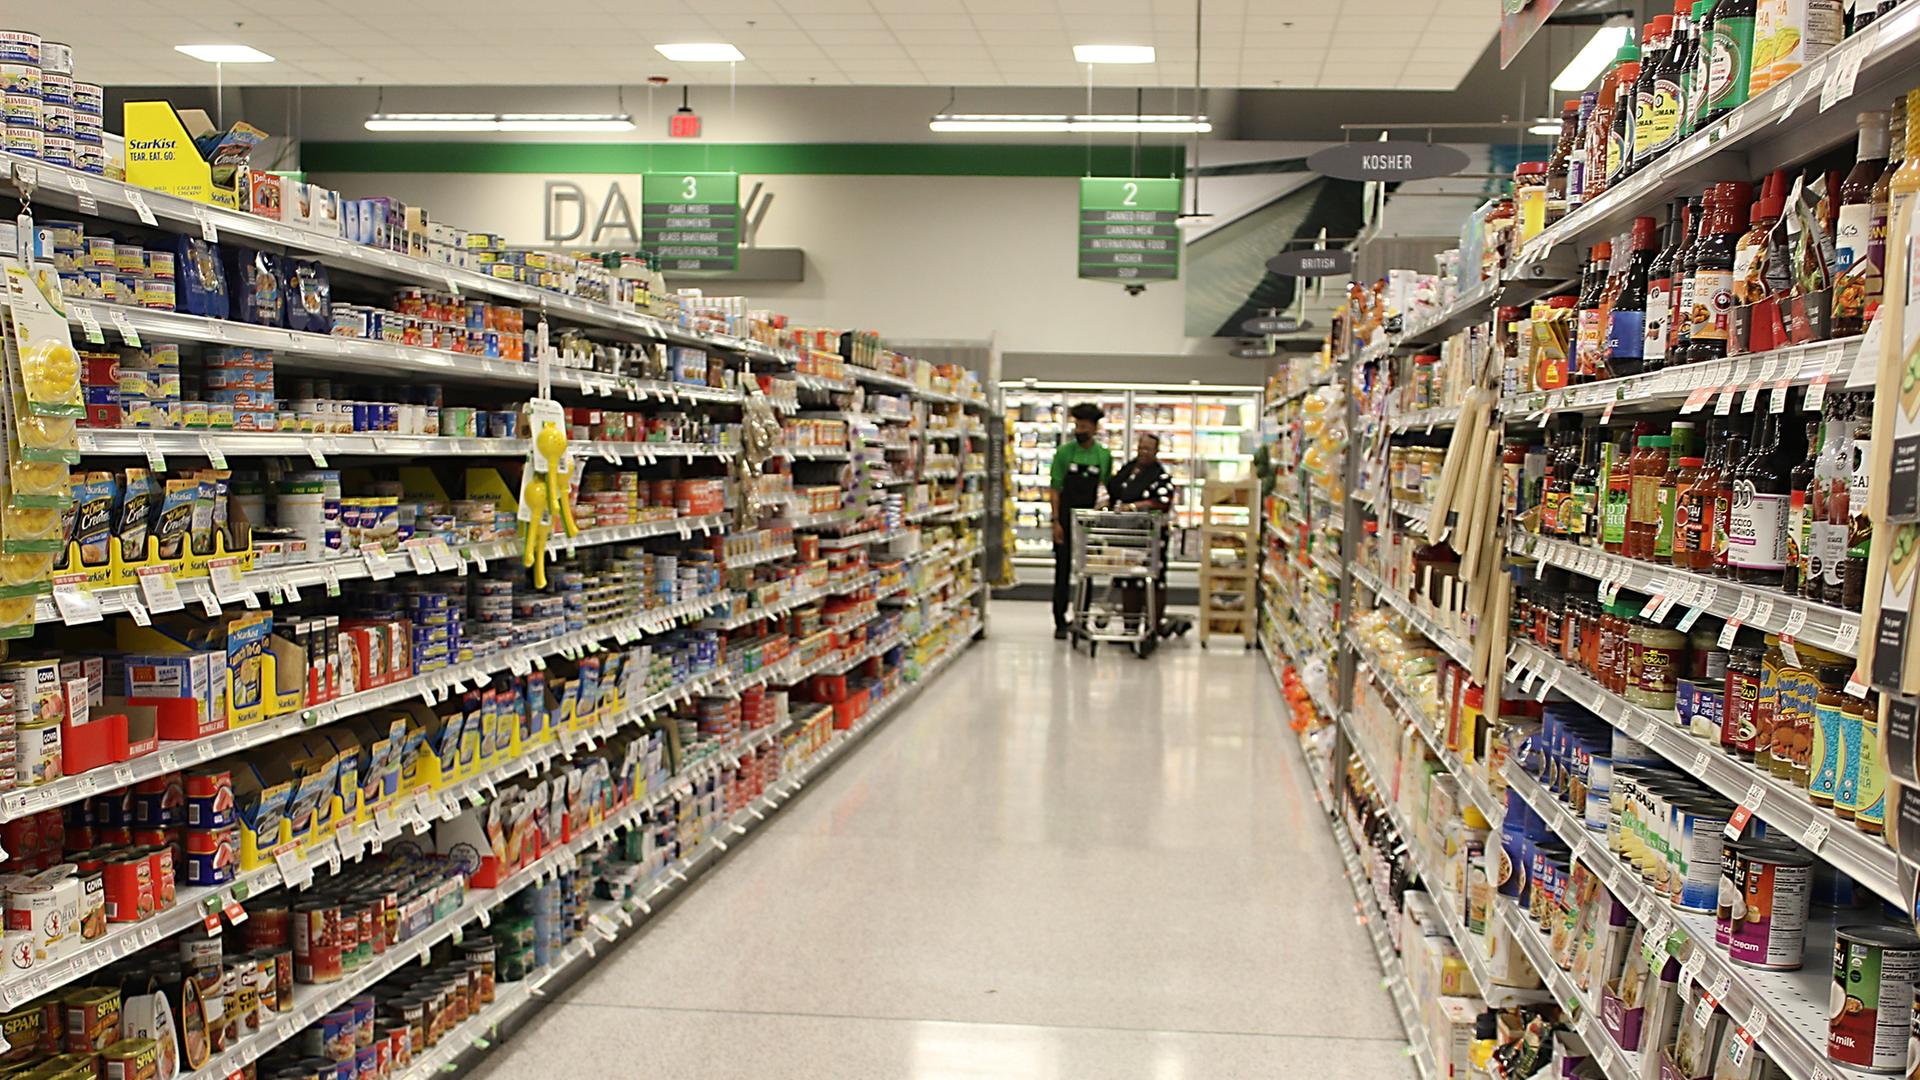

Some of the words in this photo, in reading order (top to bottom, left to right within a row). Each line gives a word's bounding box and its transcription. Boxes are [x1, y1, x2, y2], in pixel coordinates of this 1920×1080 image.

[11, 109, 36, 117] Shrimp
[672, 115, 699, 137] EXIT
[10, 140, 36, 149] Shrimp
[129, 138, 177, 150] StarKist
[130, 152, 146, 162] TEAR.
[149, 152, 163, 161] EAT.
[1363, 154, 1413, 169] KOSHER
[682, 176, 697, 199] 3
[1123, 182, 1137, 206] 2
[1105, 211, 1134, 221] CANNED
[1135, 211, 1156, 221] FRUIT
[666, 218, 711, 227] CONDIMENTS
[1105, 225, 1134, 235] CANNED
[1136, 225, 1154, 235] MEAT
[1092, 239, 1145, 249] INTERNATIONAL
[1146, 239, 1167, 249] FOOD
[1114, 253, 1142, 263] KOSHER
[1301, 258, 1336, 269] BRITISH
[1841, 623, 1853, 637] 4.99
[37, 672, 55, 683] GOYA
[216, 719, 225, 730] BEE
[43, 732, 57, 743] GOYA
[145, 740, 154, 752] BEE
[86, 878, 103, 893] GOYA
[1733, 940, 1759, 952] cream
[1881, 972, 1905, 980] Calories
[97, 997, 120, 1018] SPAM
[5, 1014, 40, 1034] SPAM
[1835, 1035, 1856, 1048] milk
[136, 1048, 157, 1069] SPAM
